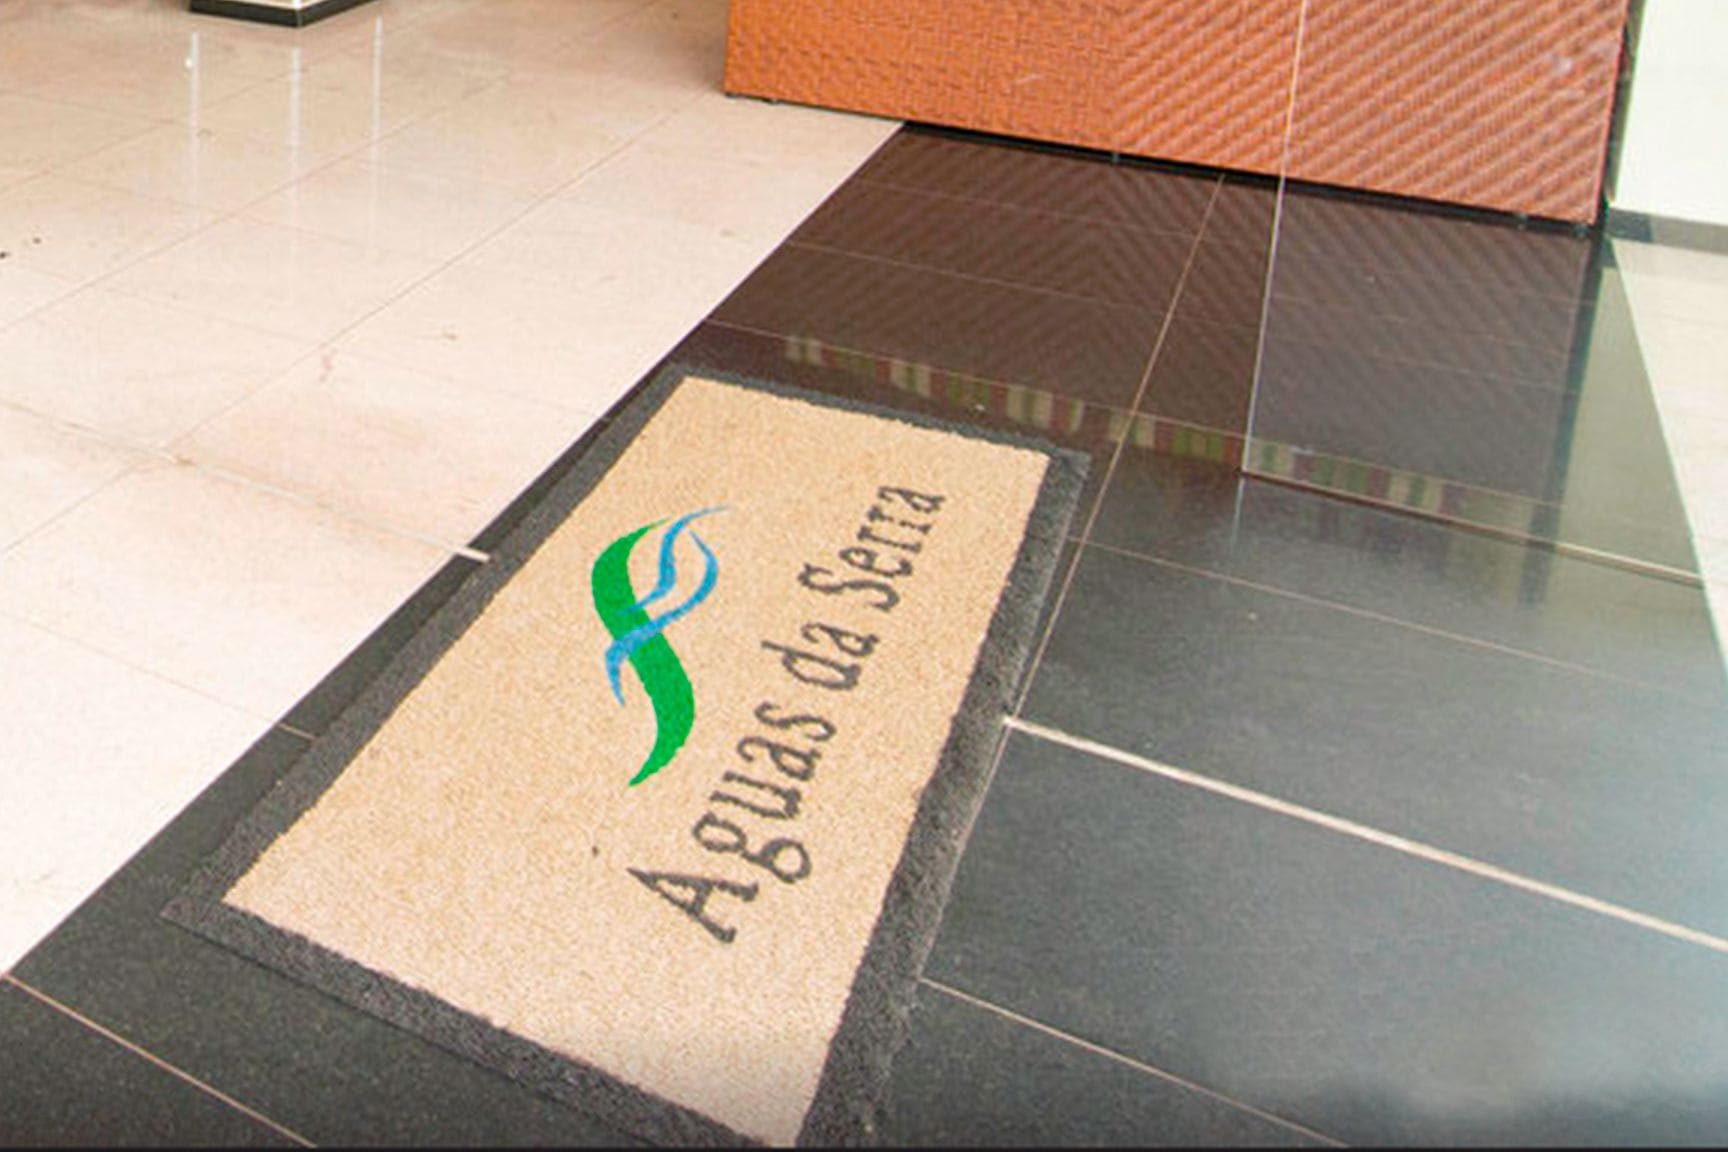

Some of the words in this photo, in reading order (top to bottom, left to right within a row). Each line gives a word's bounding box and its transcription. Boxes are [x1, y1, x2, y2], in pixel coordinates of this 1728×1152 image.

[797, 484, 947, 612] Serra
[761, 621, 881, 690] da
[627, 701, 837, 944] Aguas
